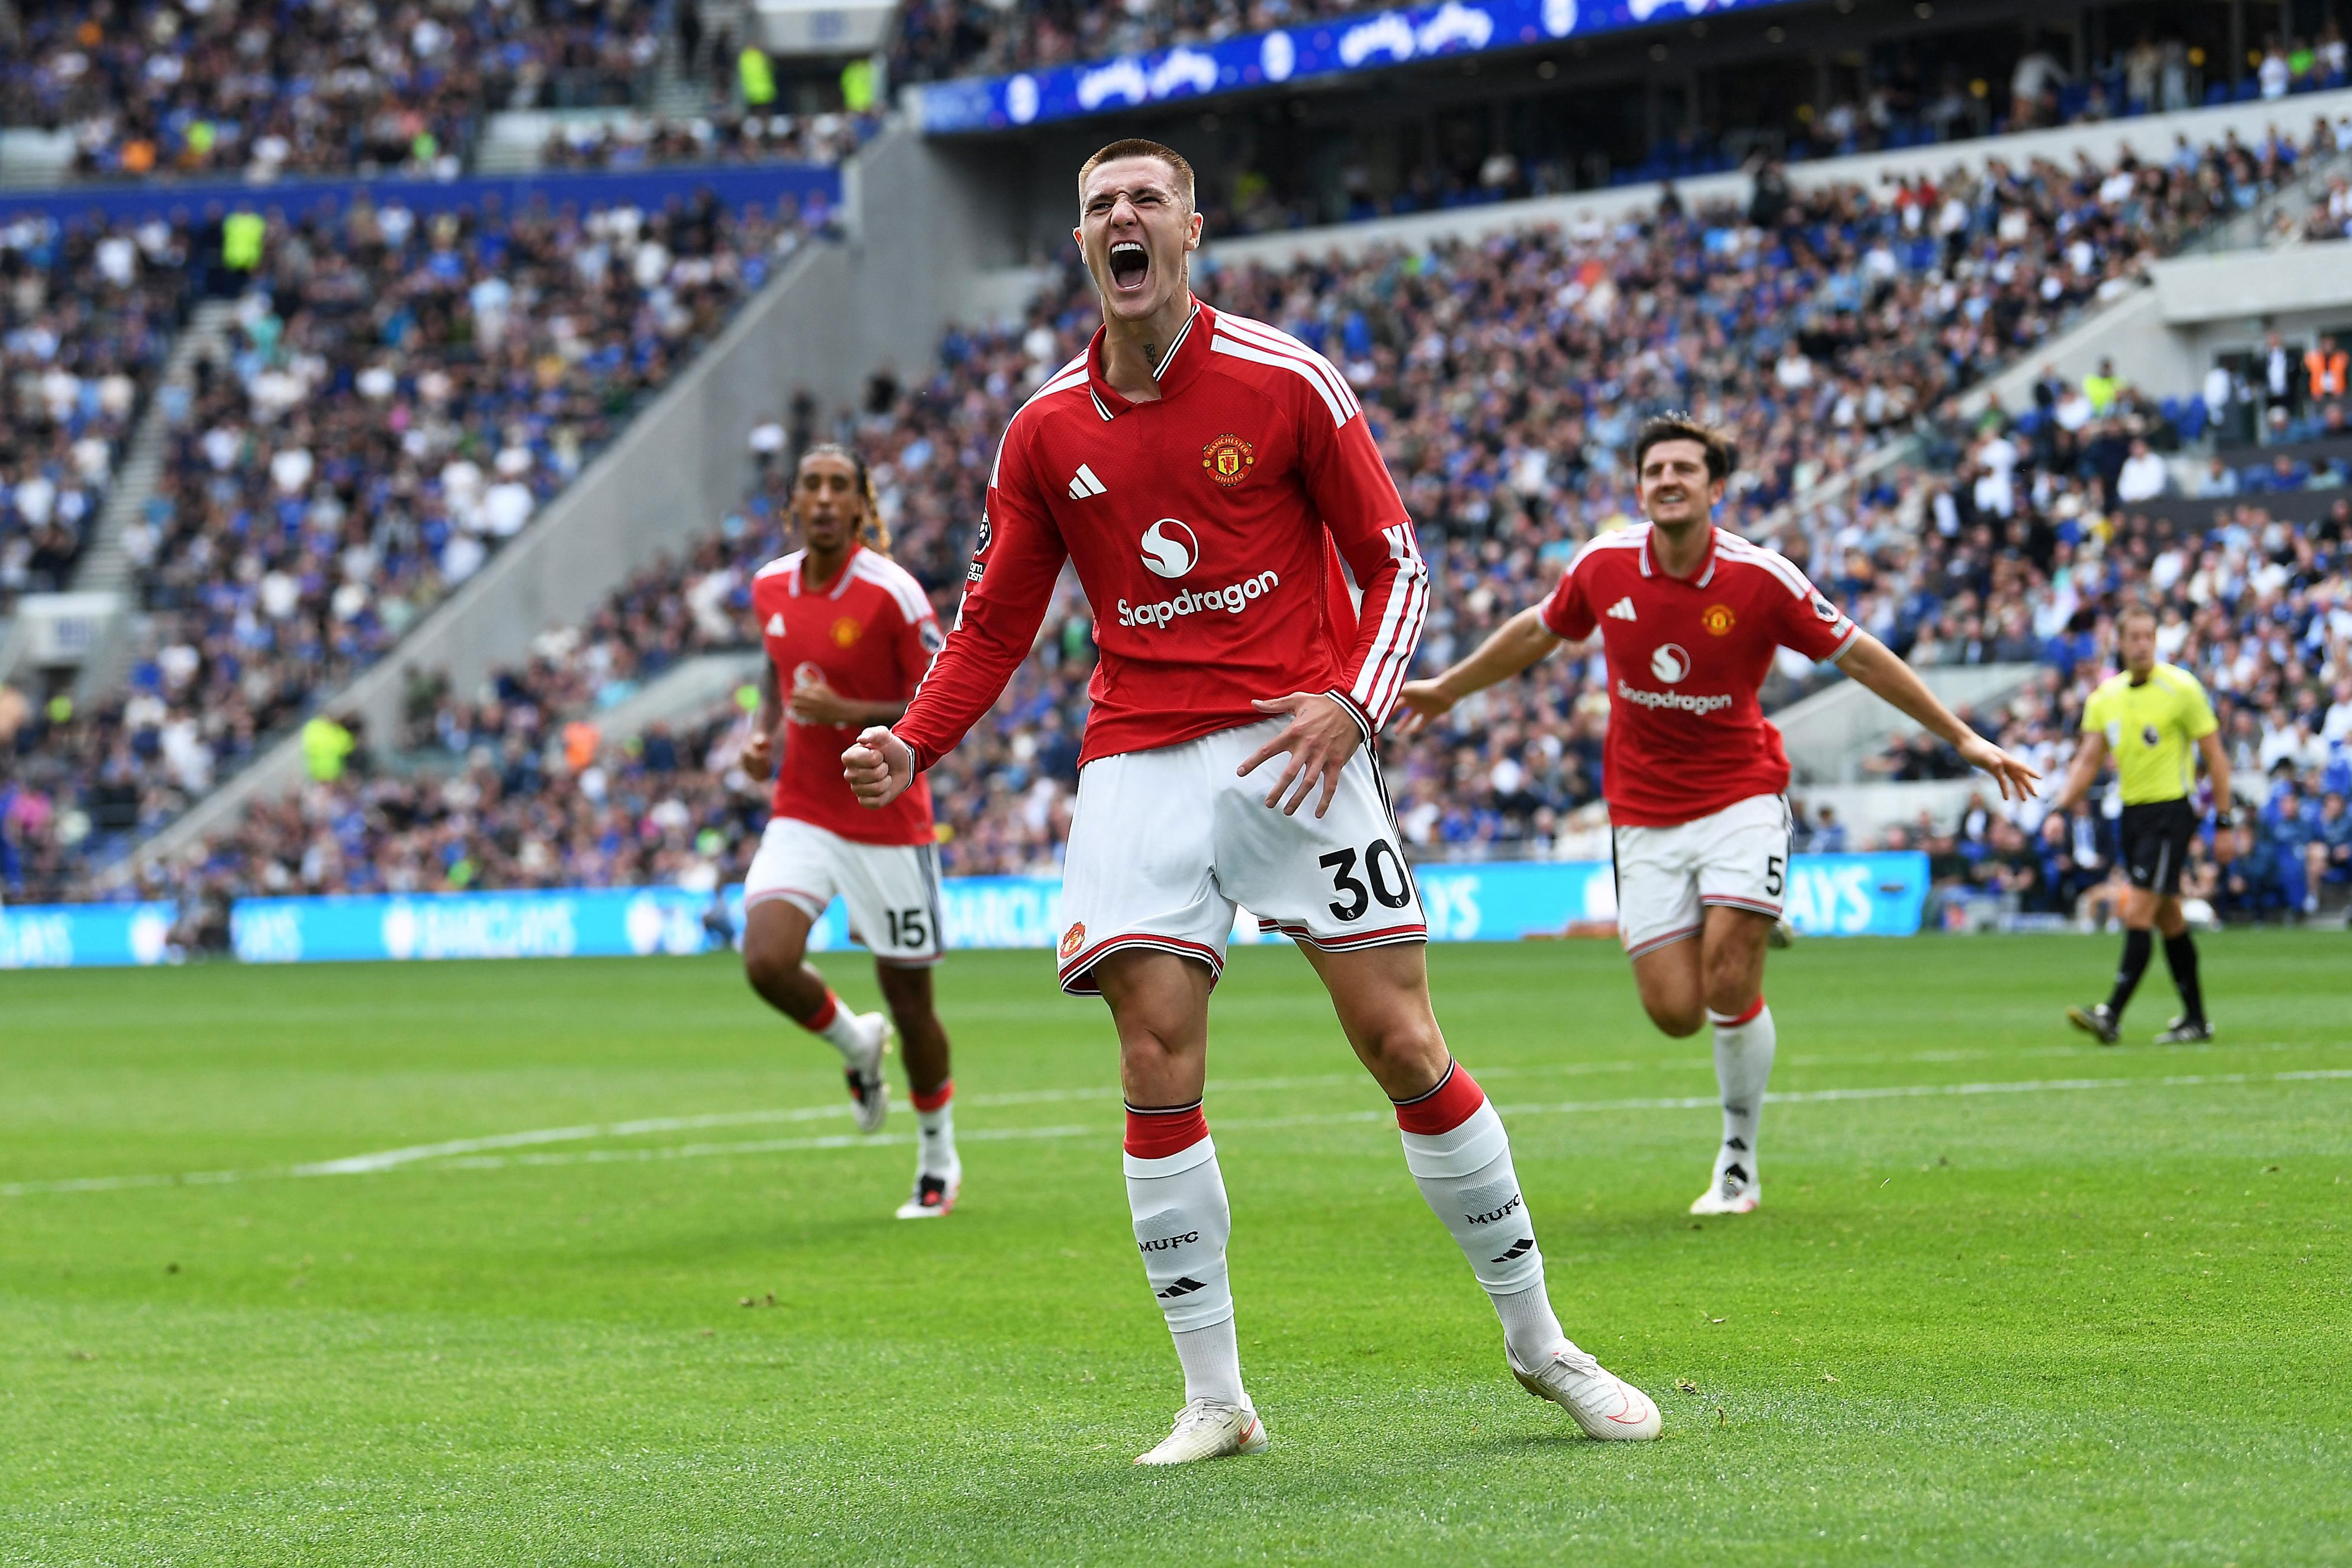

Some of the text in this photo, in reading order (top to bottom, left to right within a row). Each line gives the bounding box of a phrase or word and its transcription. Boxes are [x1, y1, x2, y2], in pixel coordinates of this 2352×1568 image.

[1207, 438, 1248, 456] MANCHESTER
[1215, 472, 1244, 483] UNITED
[1118, 570, 1279, 629] Snapdragon
[1617, 679, 1733, 716] Snapdragon
[1318, 839, 1411, 922] 30
[1765, 856, 1783, 896] 5
[885, 908, 926, 949] 15
[1464, 1193, 1520, 1224] MUFC
[1138, 1230, 1199, 1253] MUFC
